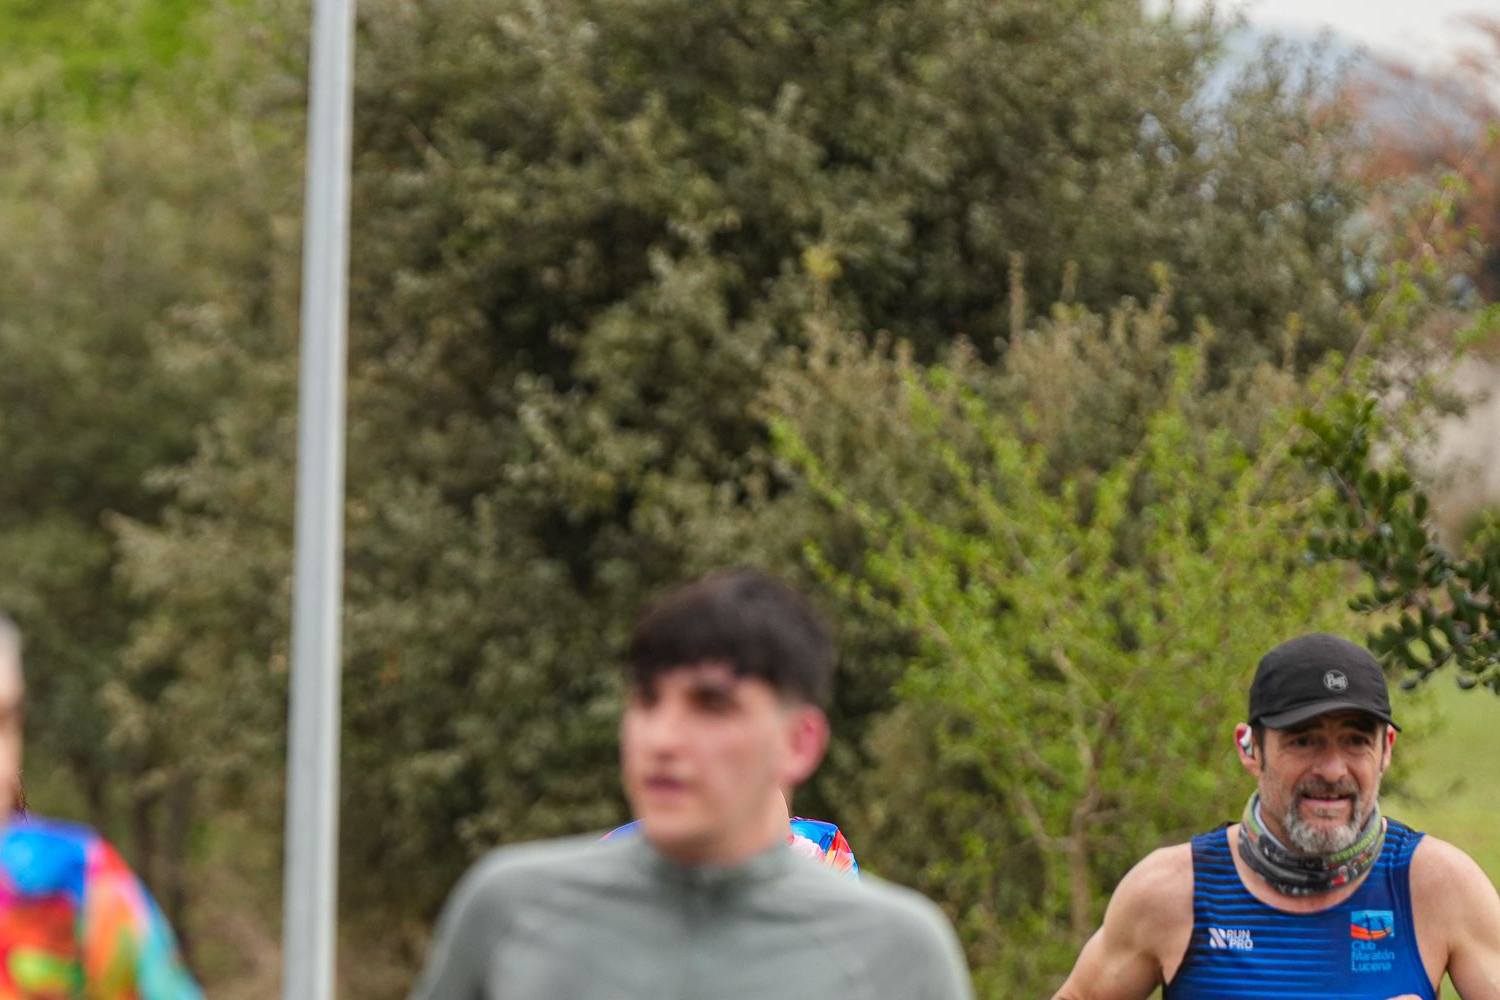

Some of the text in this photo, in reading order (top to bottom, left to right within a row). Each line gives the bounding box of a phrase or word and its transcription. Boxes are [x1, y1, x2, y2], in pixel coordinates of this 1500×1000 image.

[1227, 929, 1251, 939] RUN
[1229, 939, 1254, 951] PRO
[1351, 940, 1376, 950] Club
[1351, 949, 1395, 960] Maratón
[1351, 960, 1392, 971] Lucena
